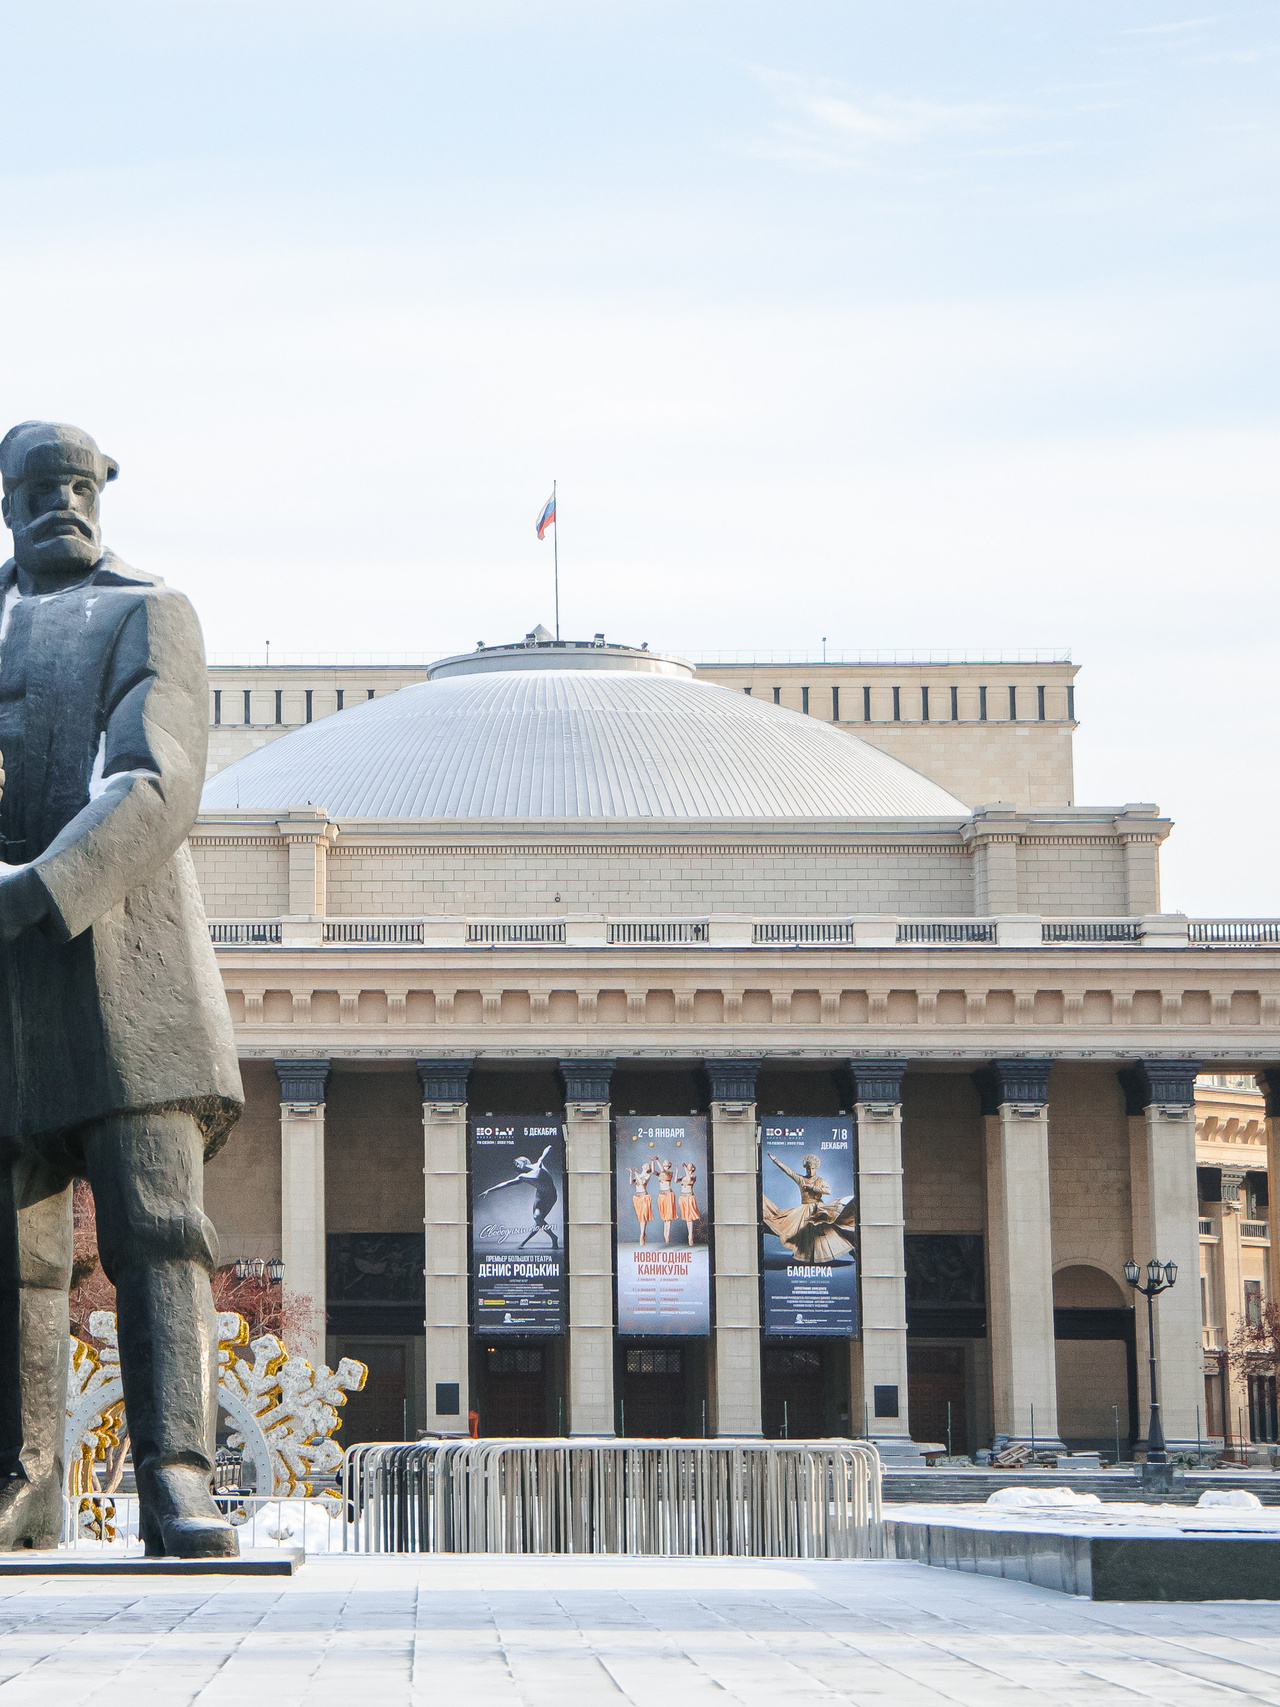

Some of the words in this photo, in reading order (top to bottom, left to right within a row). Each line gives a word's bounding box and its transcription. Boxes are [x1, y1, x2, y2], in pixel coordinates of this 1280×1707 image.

[523, 1127, 528, 1136] 5
[529, 1127, 557, 1137] ДЕКАБРЯ
[655, 1128, 685, 1138] ЯНВАРЯ
[821, 1141, 848, 1150] ДЕКАБРЯ
[480, 1224, 526, 1244] Свободный
[634, 1252, 692, 1264] НОВОГОДНИЕ
[478, 1264, 511, 1278] ДЕНИС
[514, 1264, 560, 1278] РОДЬКИН
[638, 1264, 688, 1276] КАНИКУЛЫ
[787, 1266, 833, 1278] БАЯДЕРКА
